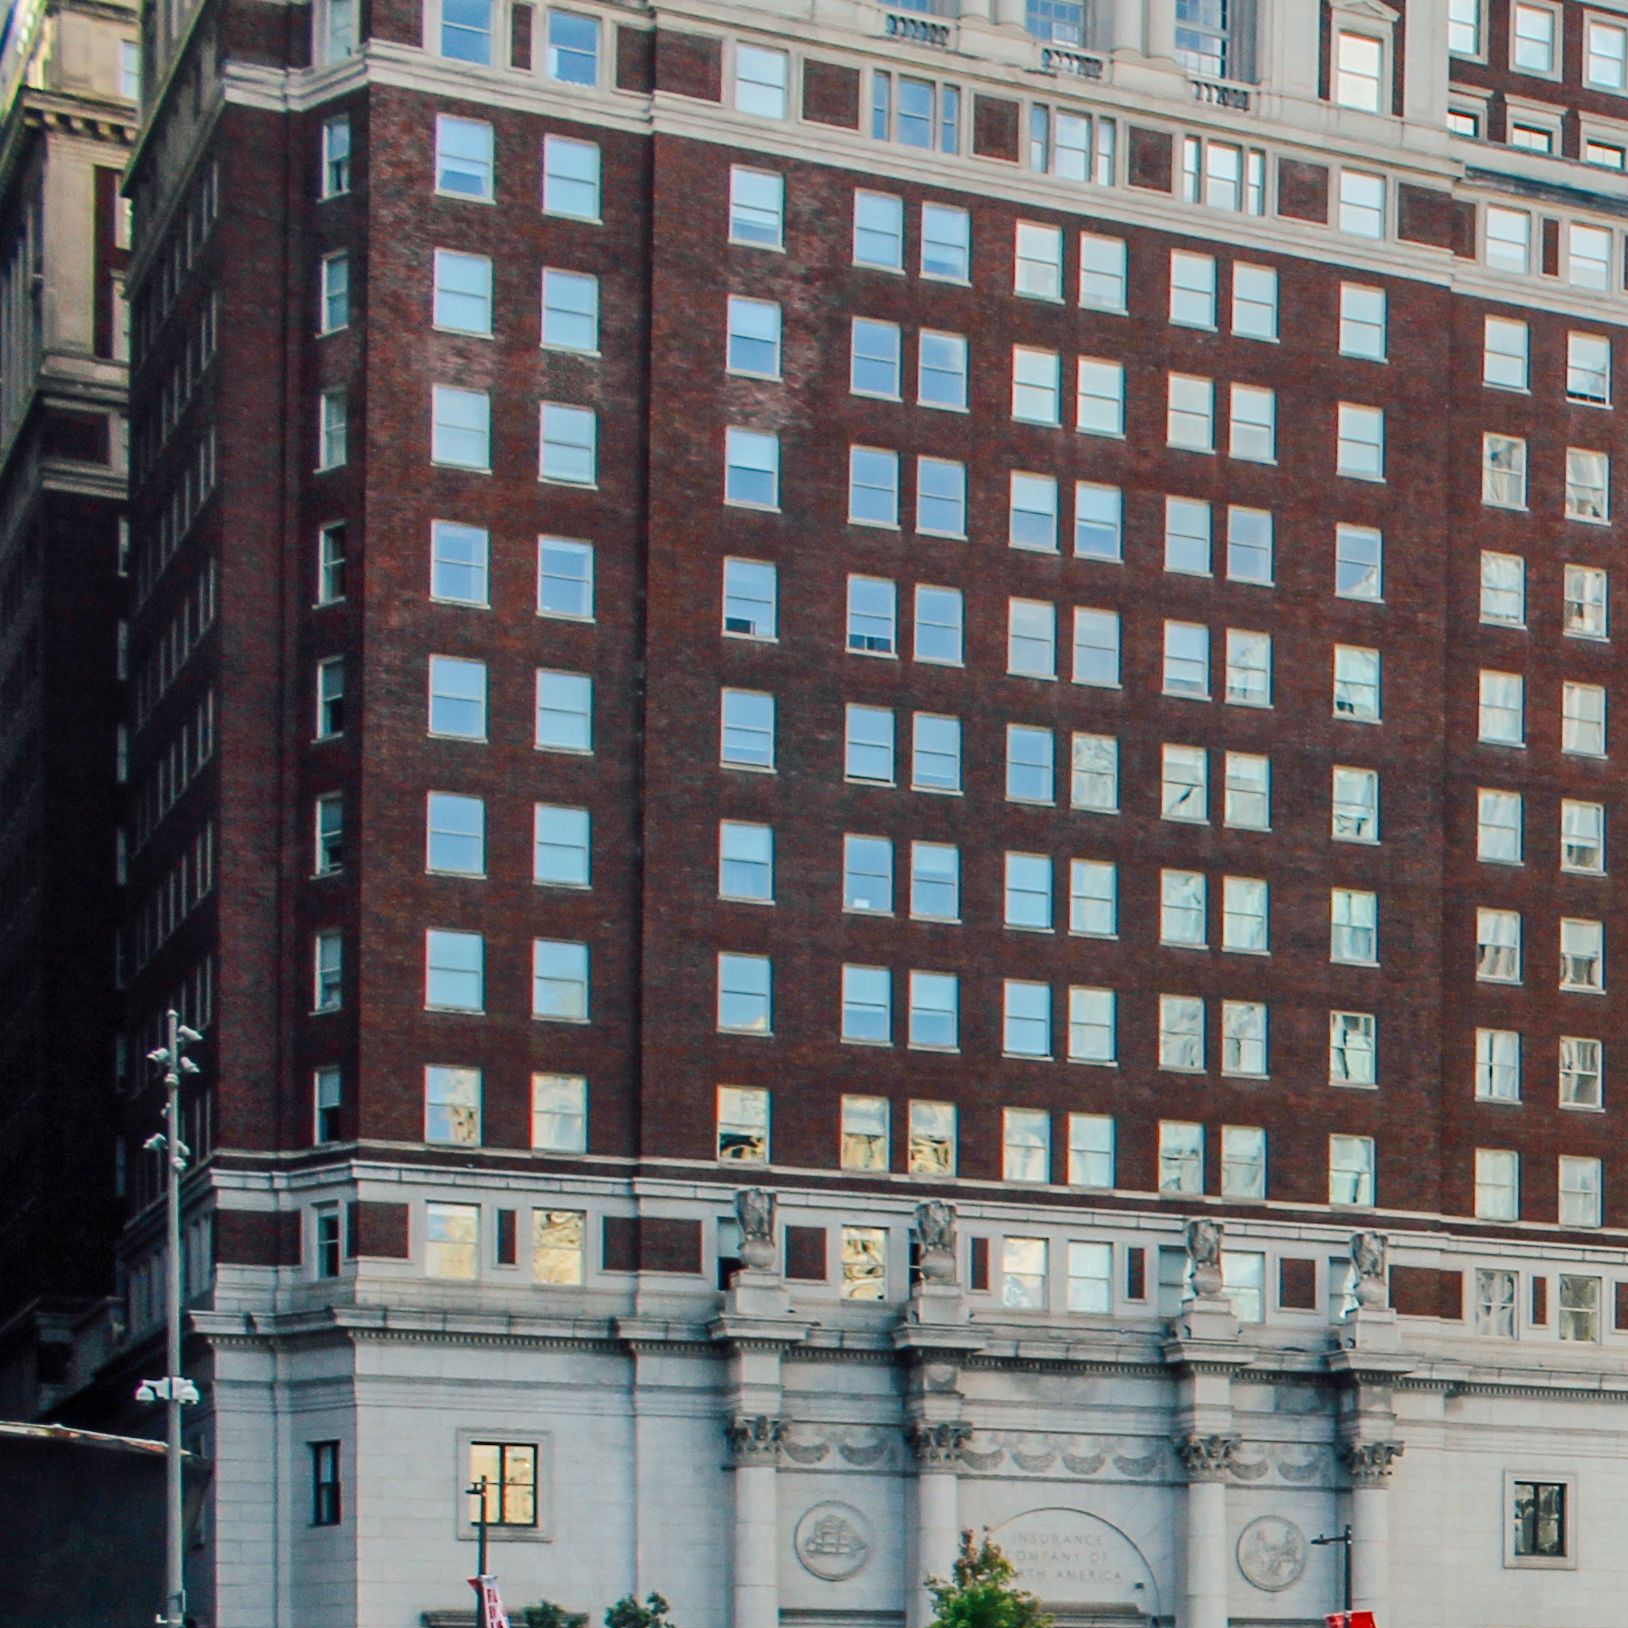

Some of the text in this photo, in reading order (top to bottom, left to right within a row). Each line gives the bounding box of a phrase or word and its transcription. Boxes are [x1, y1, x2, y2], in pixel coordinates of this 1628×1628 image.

[1012, 1533, 1104, 1546] INSURANCE
[1089, 1551, 1108, 1563] OF
[1056, 1569, 1121, 1581] AMERICA
